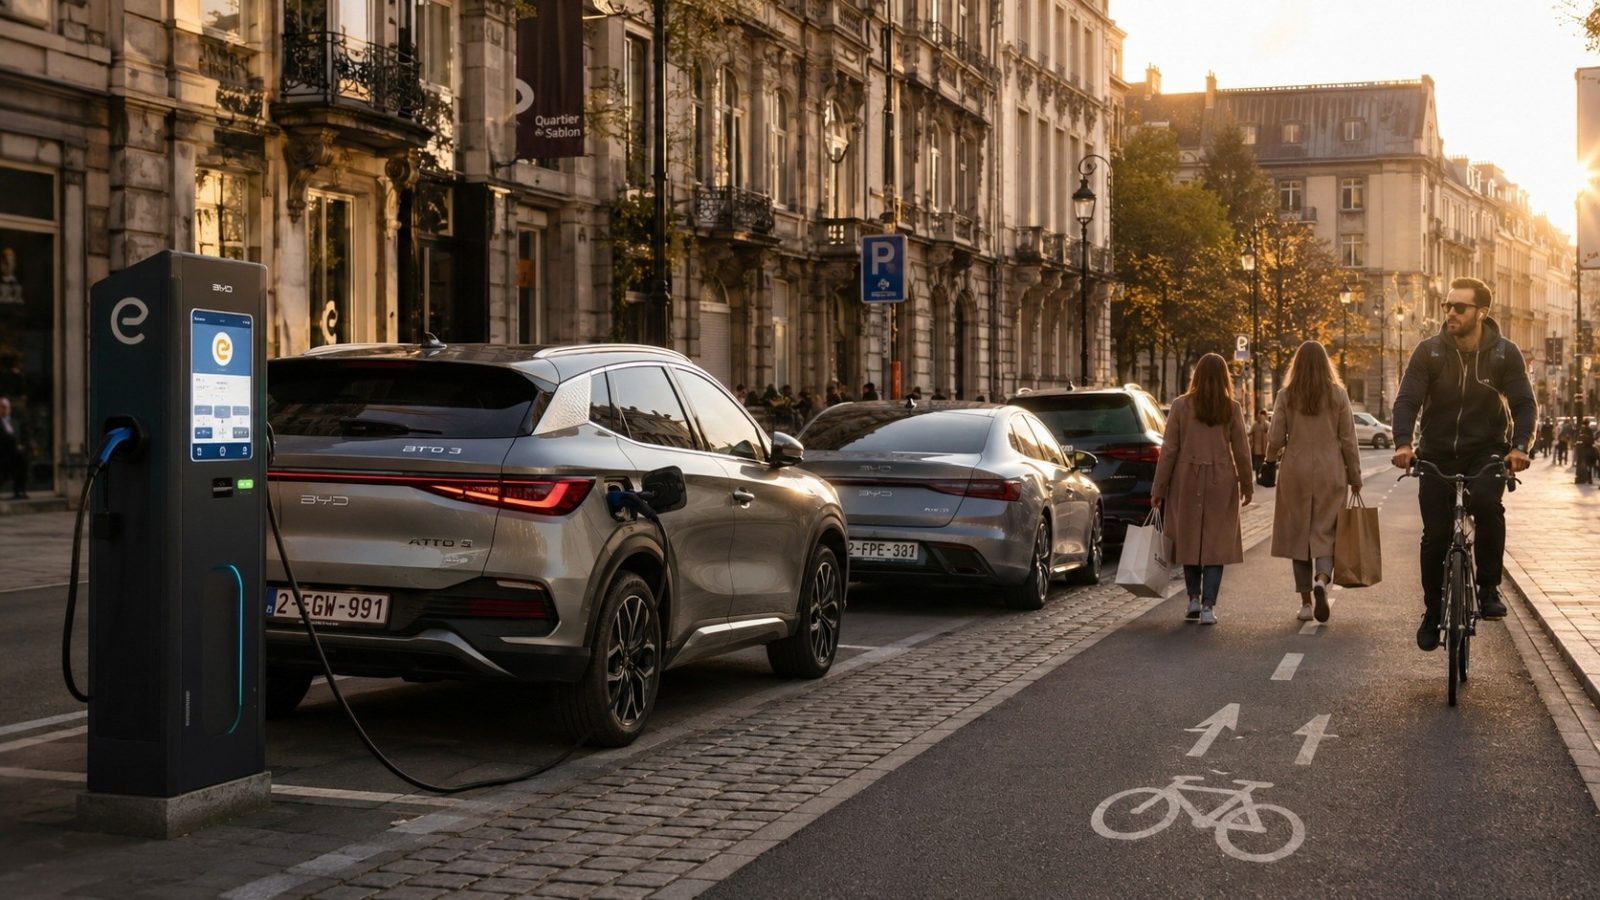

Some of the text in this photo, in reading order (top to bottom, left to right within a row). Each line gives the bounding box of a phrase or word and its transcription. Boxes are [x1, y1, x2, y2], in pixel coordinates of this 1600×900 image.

[535, 114, 580, 128] Quartier
[545, 126, 581, 139] Sablon
[871, 241, 895, 275] P
[300, 494, 349, 506] BYD
[408, 538, 455, 548] ATTO
